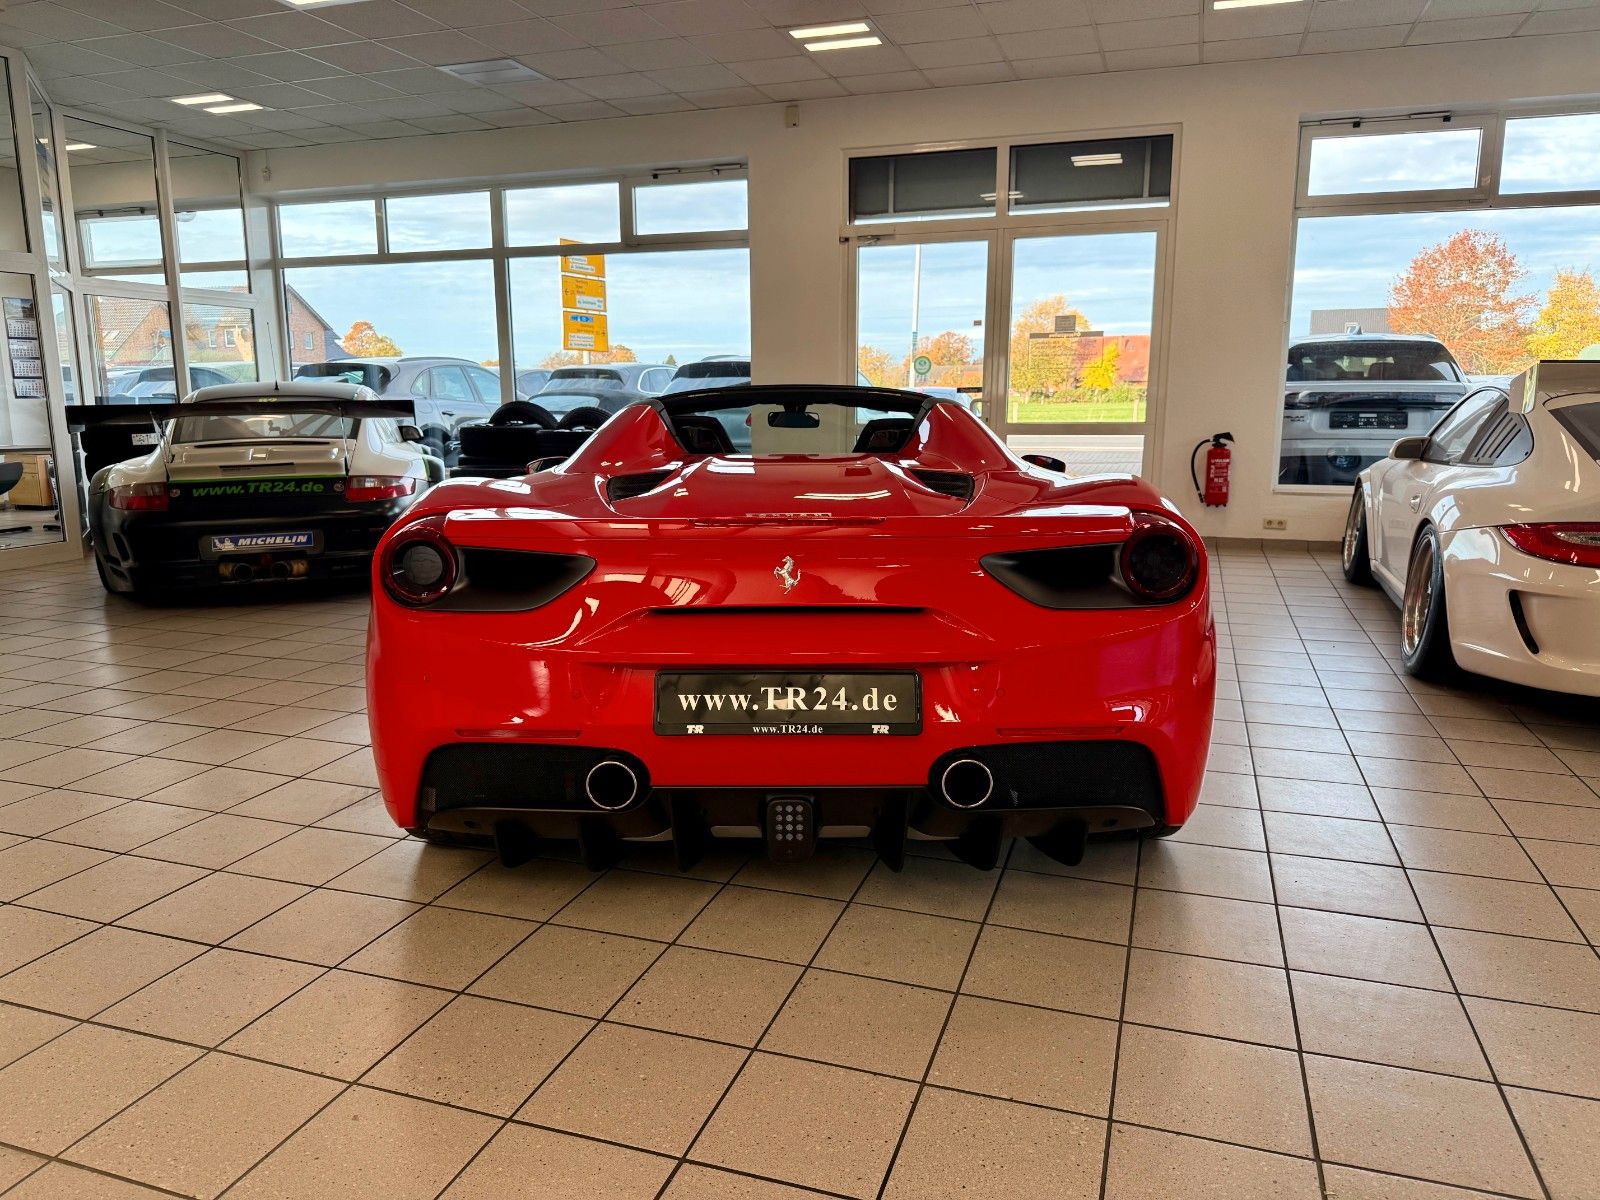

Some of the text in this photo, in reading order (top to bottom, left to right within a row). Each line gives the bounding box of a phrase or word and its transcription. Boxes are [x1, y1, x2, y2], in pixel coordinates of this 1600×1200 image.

[192, 481, 325, 497] www.TR24.de
[237, 534, 308, 546] MICHELIN
[677, 686, 898, 711] www.TR24.de
[752, 724, 824, 734] www.TR24.de
